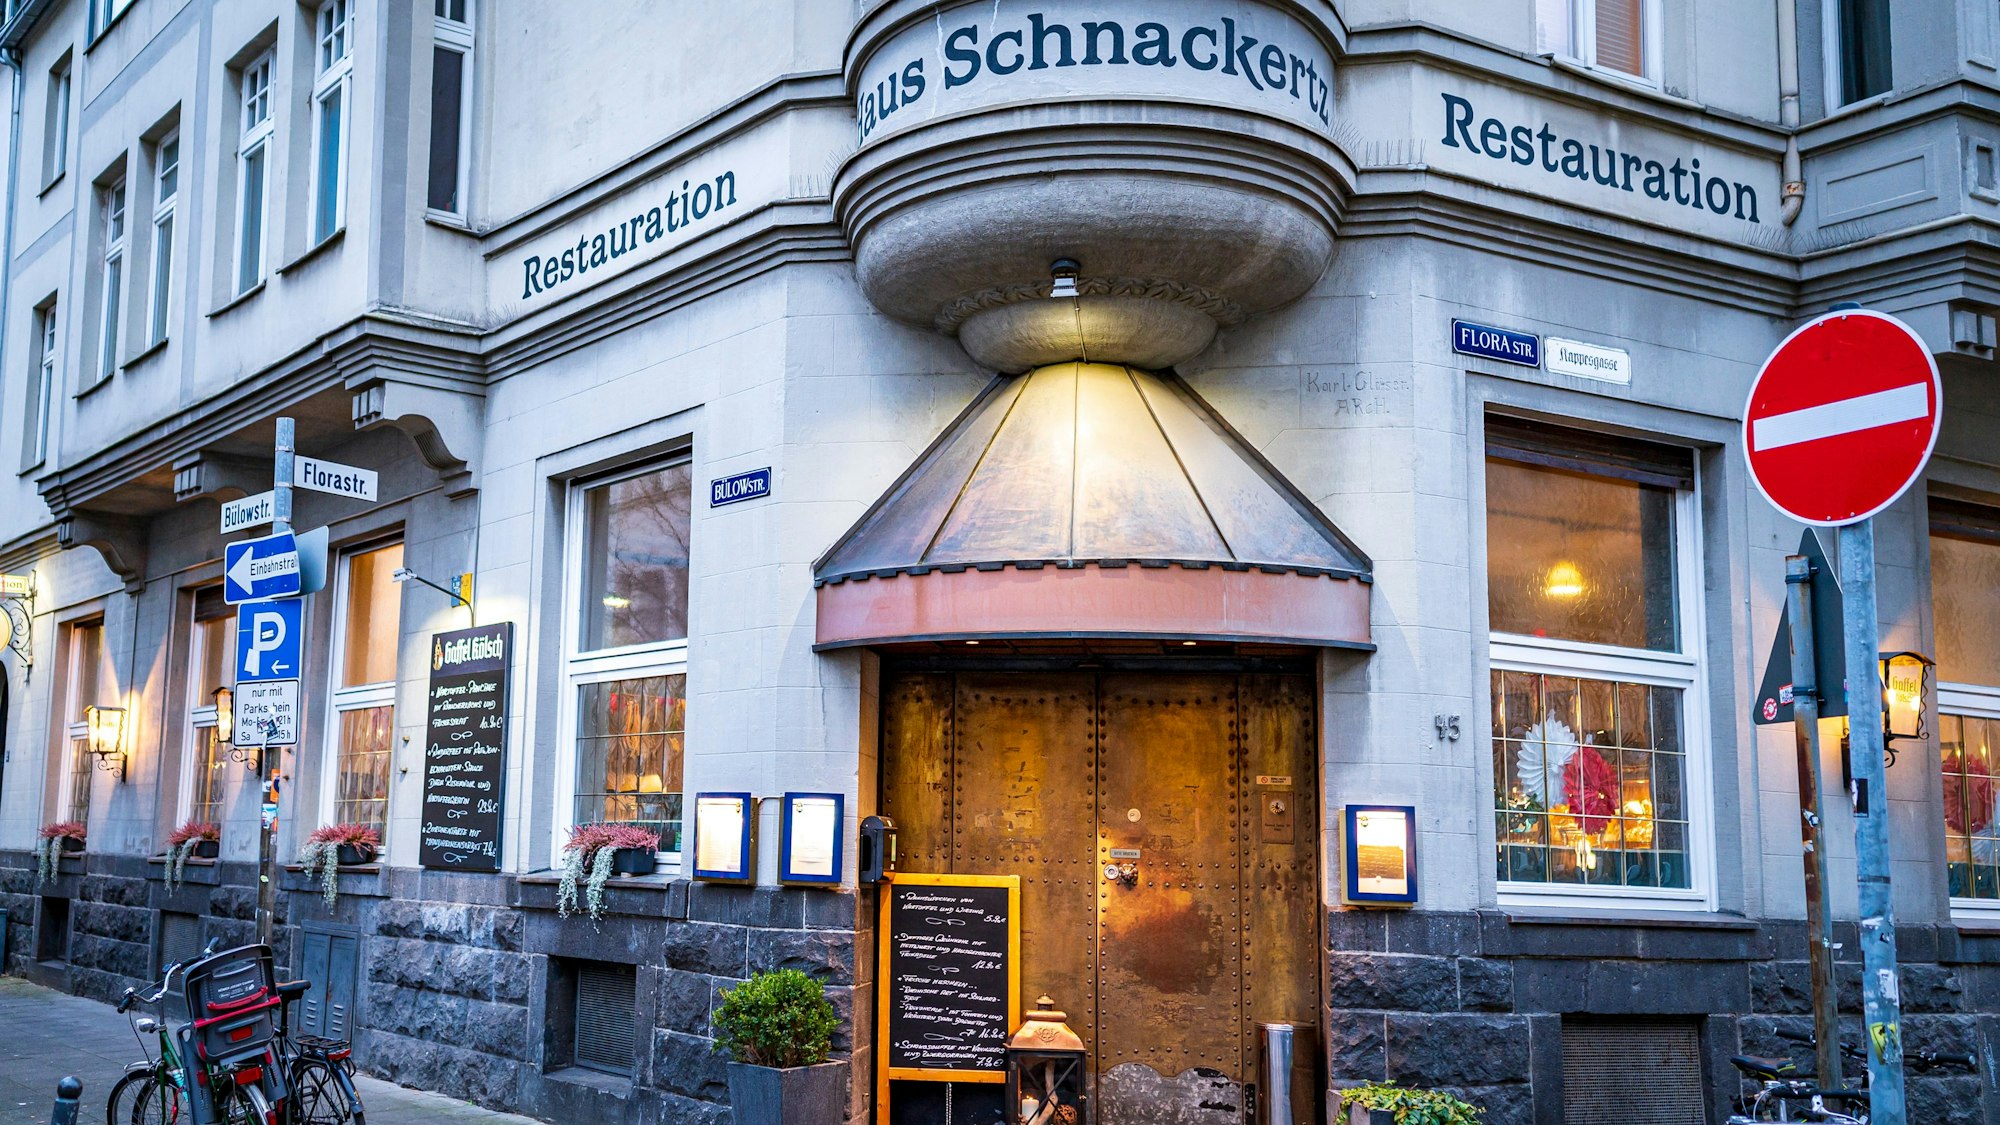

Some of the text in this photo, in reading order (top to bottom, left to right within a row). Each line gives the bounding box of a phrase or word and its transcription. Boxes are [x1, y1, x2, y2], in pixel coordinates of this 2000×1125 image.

[944, 12, 1330, 127] Schnackertz
[1441, 92, 1760, 224] Restauration
[522, 170, 737, 300] Restauration
[1461, 327, 1535, 359] FLORA STR.
[303, 461, 368, 496] Florastr.
[224, 498, 271, 528] Bülowstr.
[444, 633, 504, 665] Gaffel Kölsch
[252, 687, 283, 698] nur mit
[1892, 676, 1918, 692] Gaffel
[243, 701, 291, 715] Parkshein
[240, 731, 251, 742] Sa
[1434, 714, 1460, 742] 45
[902, 902, 938, 911] KARTOFFEL
[939, 906, 954, 914] UND
[936, 946, 951, 954] UND
[903, 1051, 921, 1060] UND
